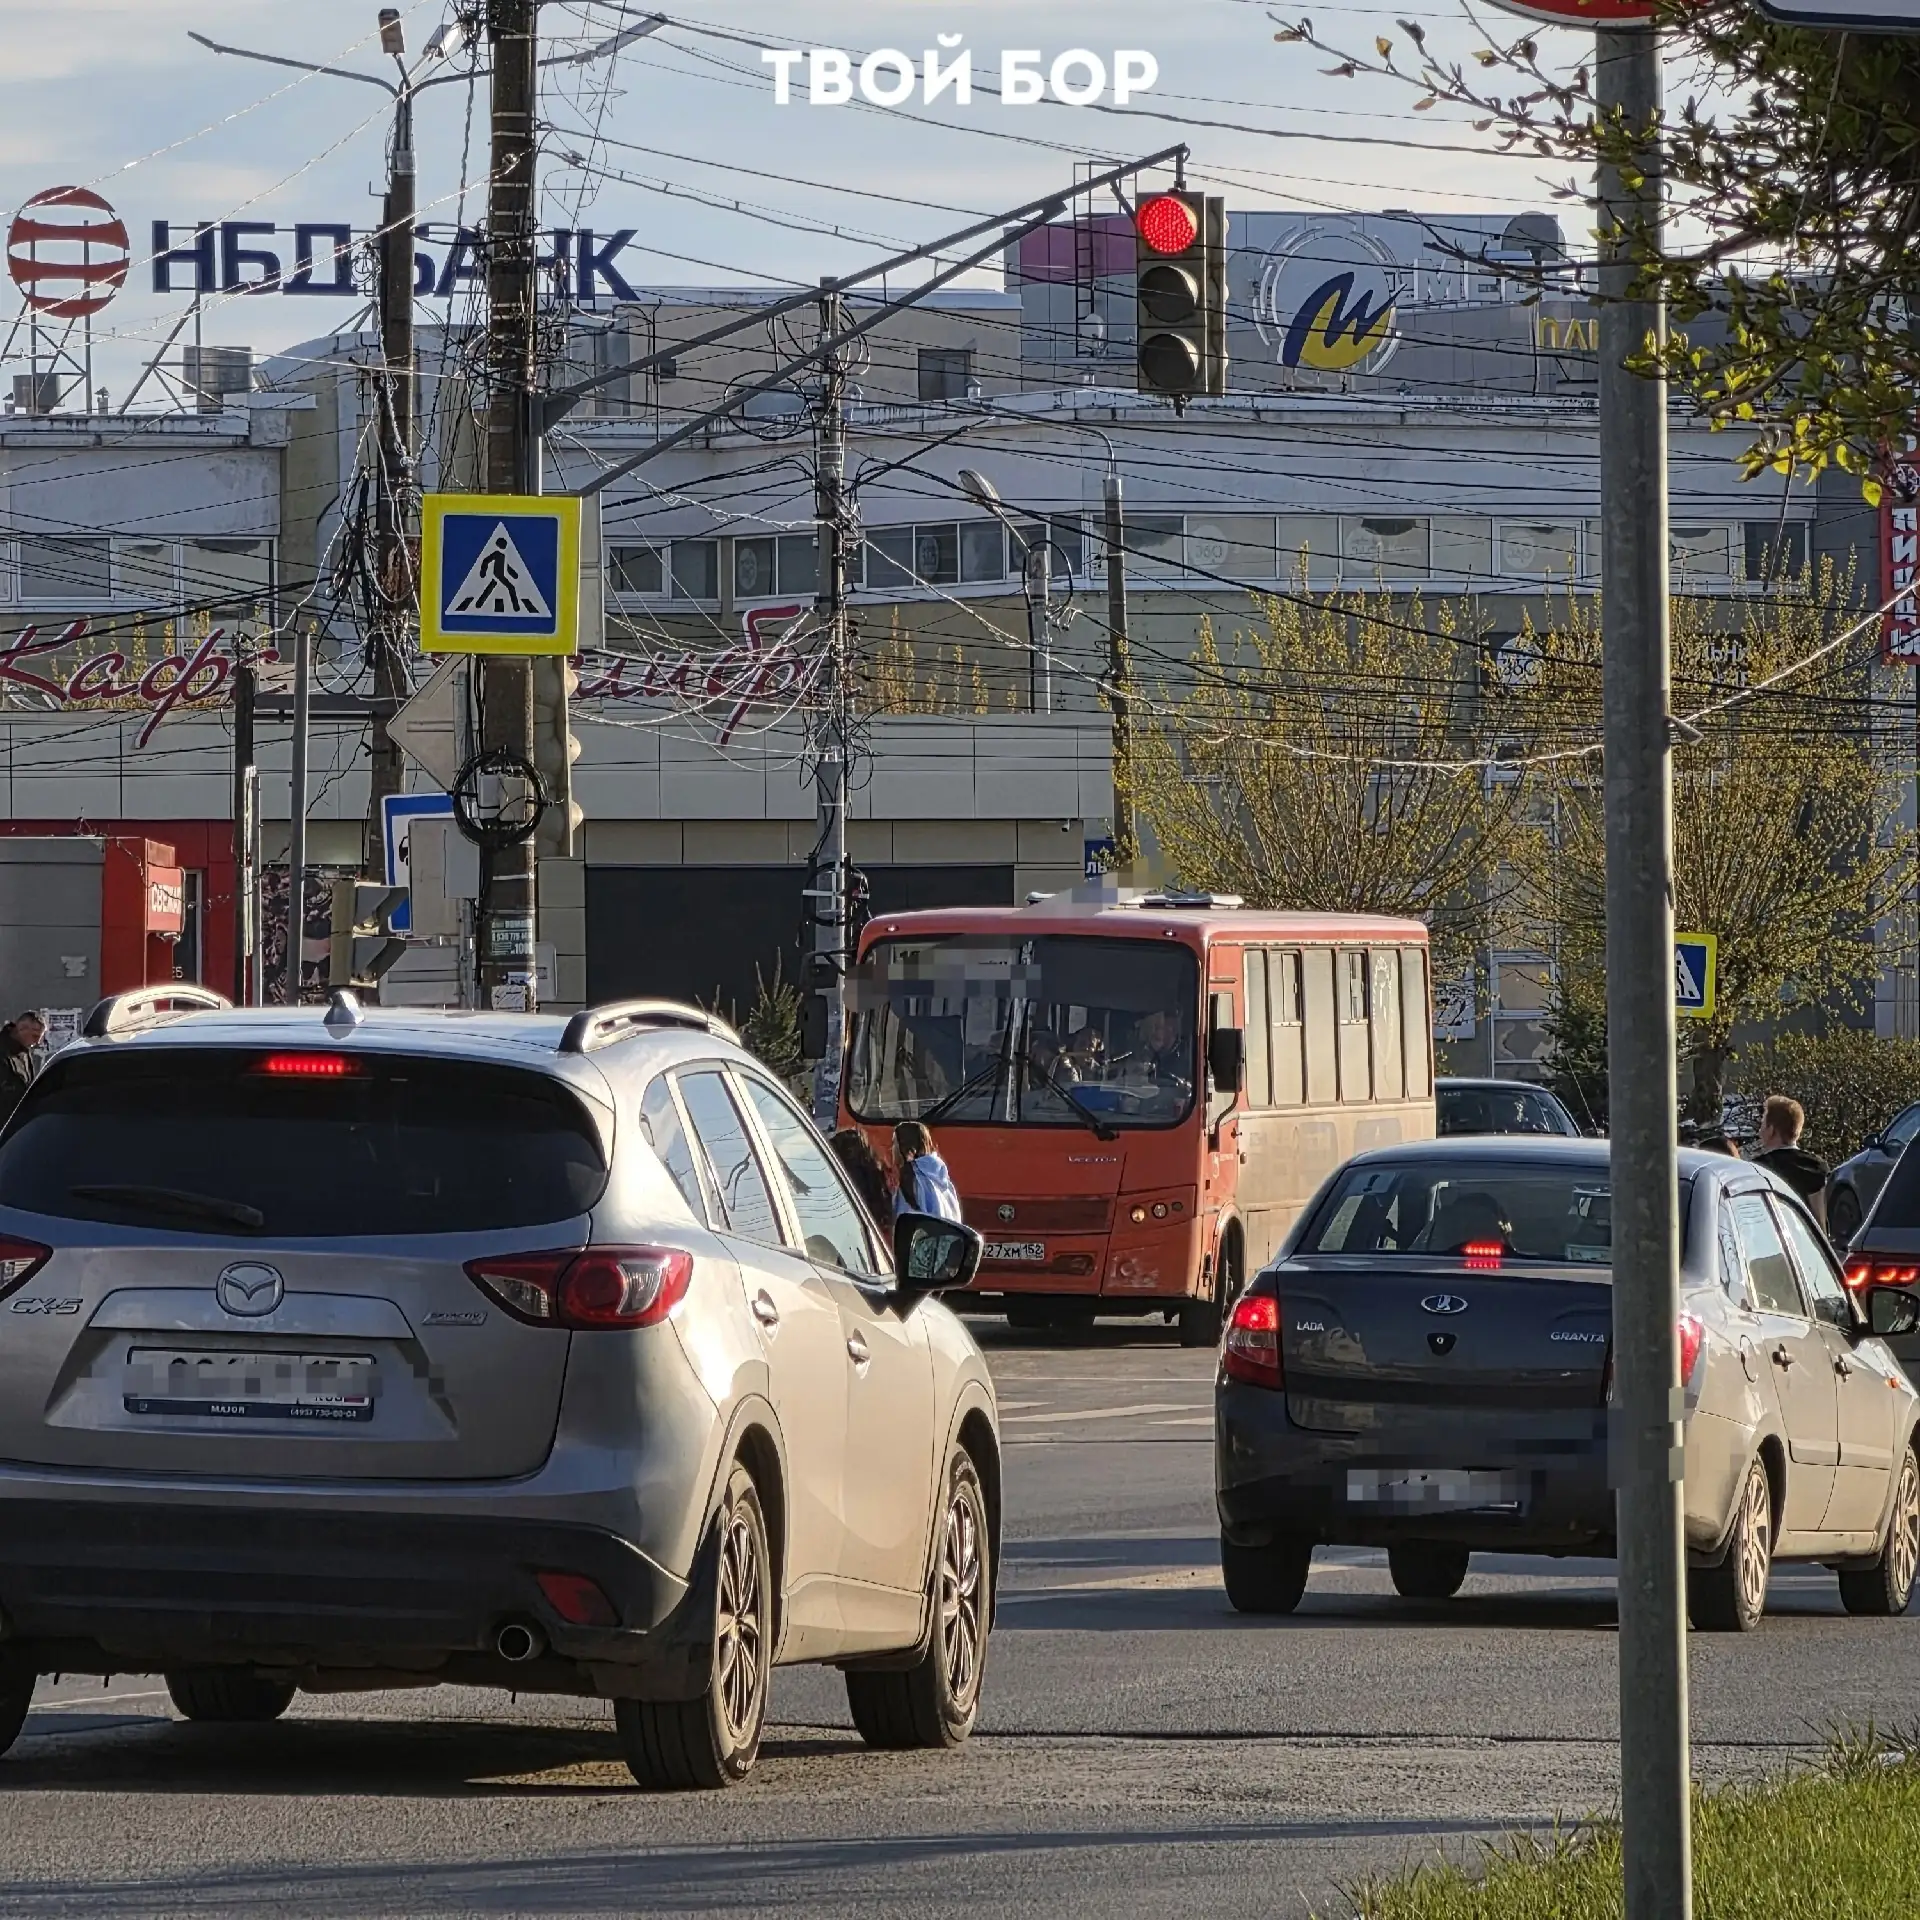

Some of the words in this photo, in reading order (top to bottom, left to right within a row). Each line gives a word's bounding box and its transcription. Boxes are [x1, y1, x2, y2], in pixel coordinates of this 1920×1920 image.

[152, 220, 358, 296] НБД
[10, 1298, 83, 1314] CX-5
[1297, 1321, 1324, 1331] LADA
[1550, 1331, 1604, 1343] GRANTA
[211, 1405, 245, 1414] MAJOR
